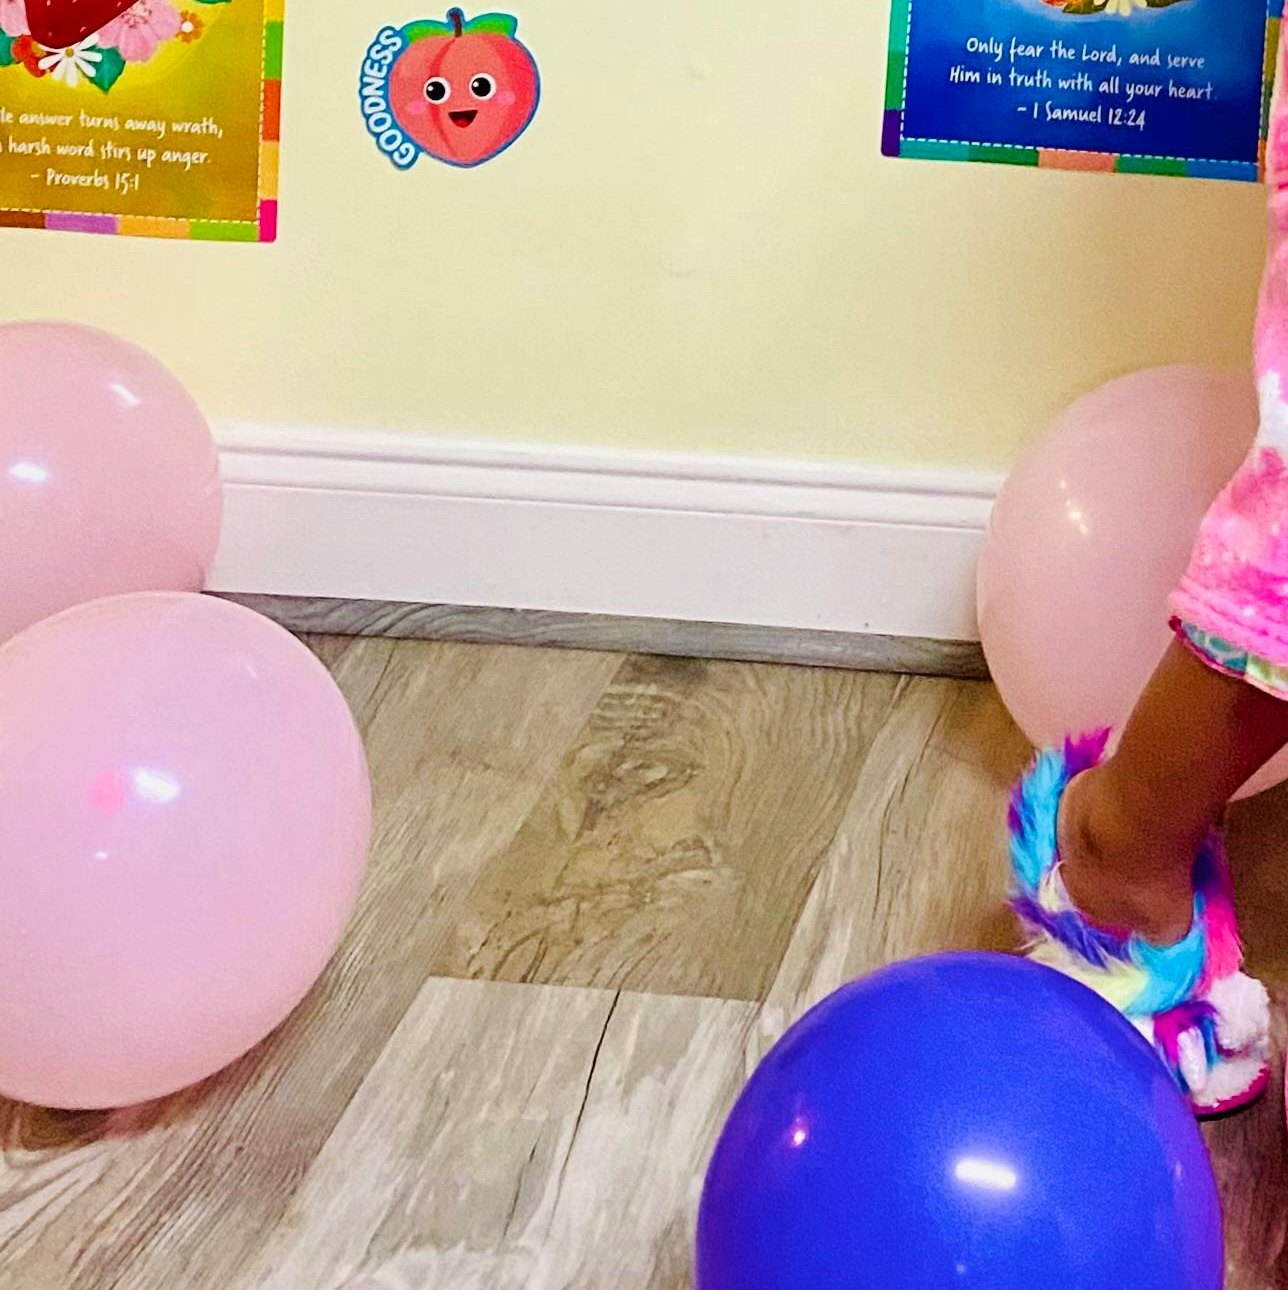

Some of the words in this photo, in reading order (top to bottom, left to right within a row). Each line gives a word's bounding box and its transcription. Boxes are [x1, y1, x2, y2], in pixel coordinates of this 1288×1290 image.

[967, 37, 1003, 62] Only
[1007, 40, 1045, 64] fear
[1050, 40, 1075, 59] the
[1082, 44, 1122, 66] Lord,
[1129, 48, 1160, 65] and
[1168, 54, 1205, 68] serve
[362, 29, 415, 166] GOODNESS
